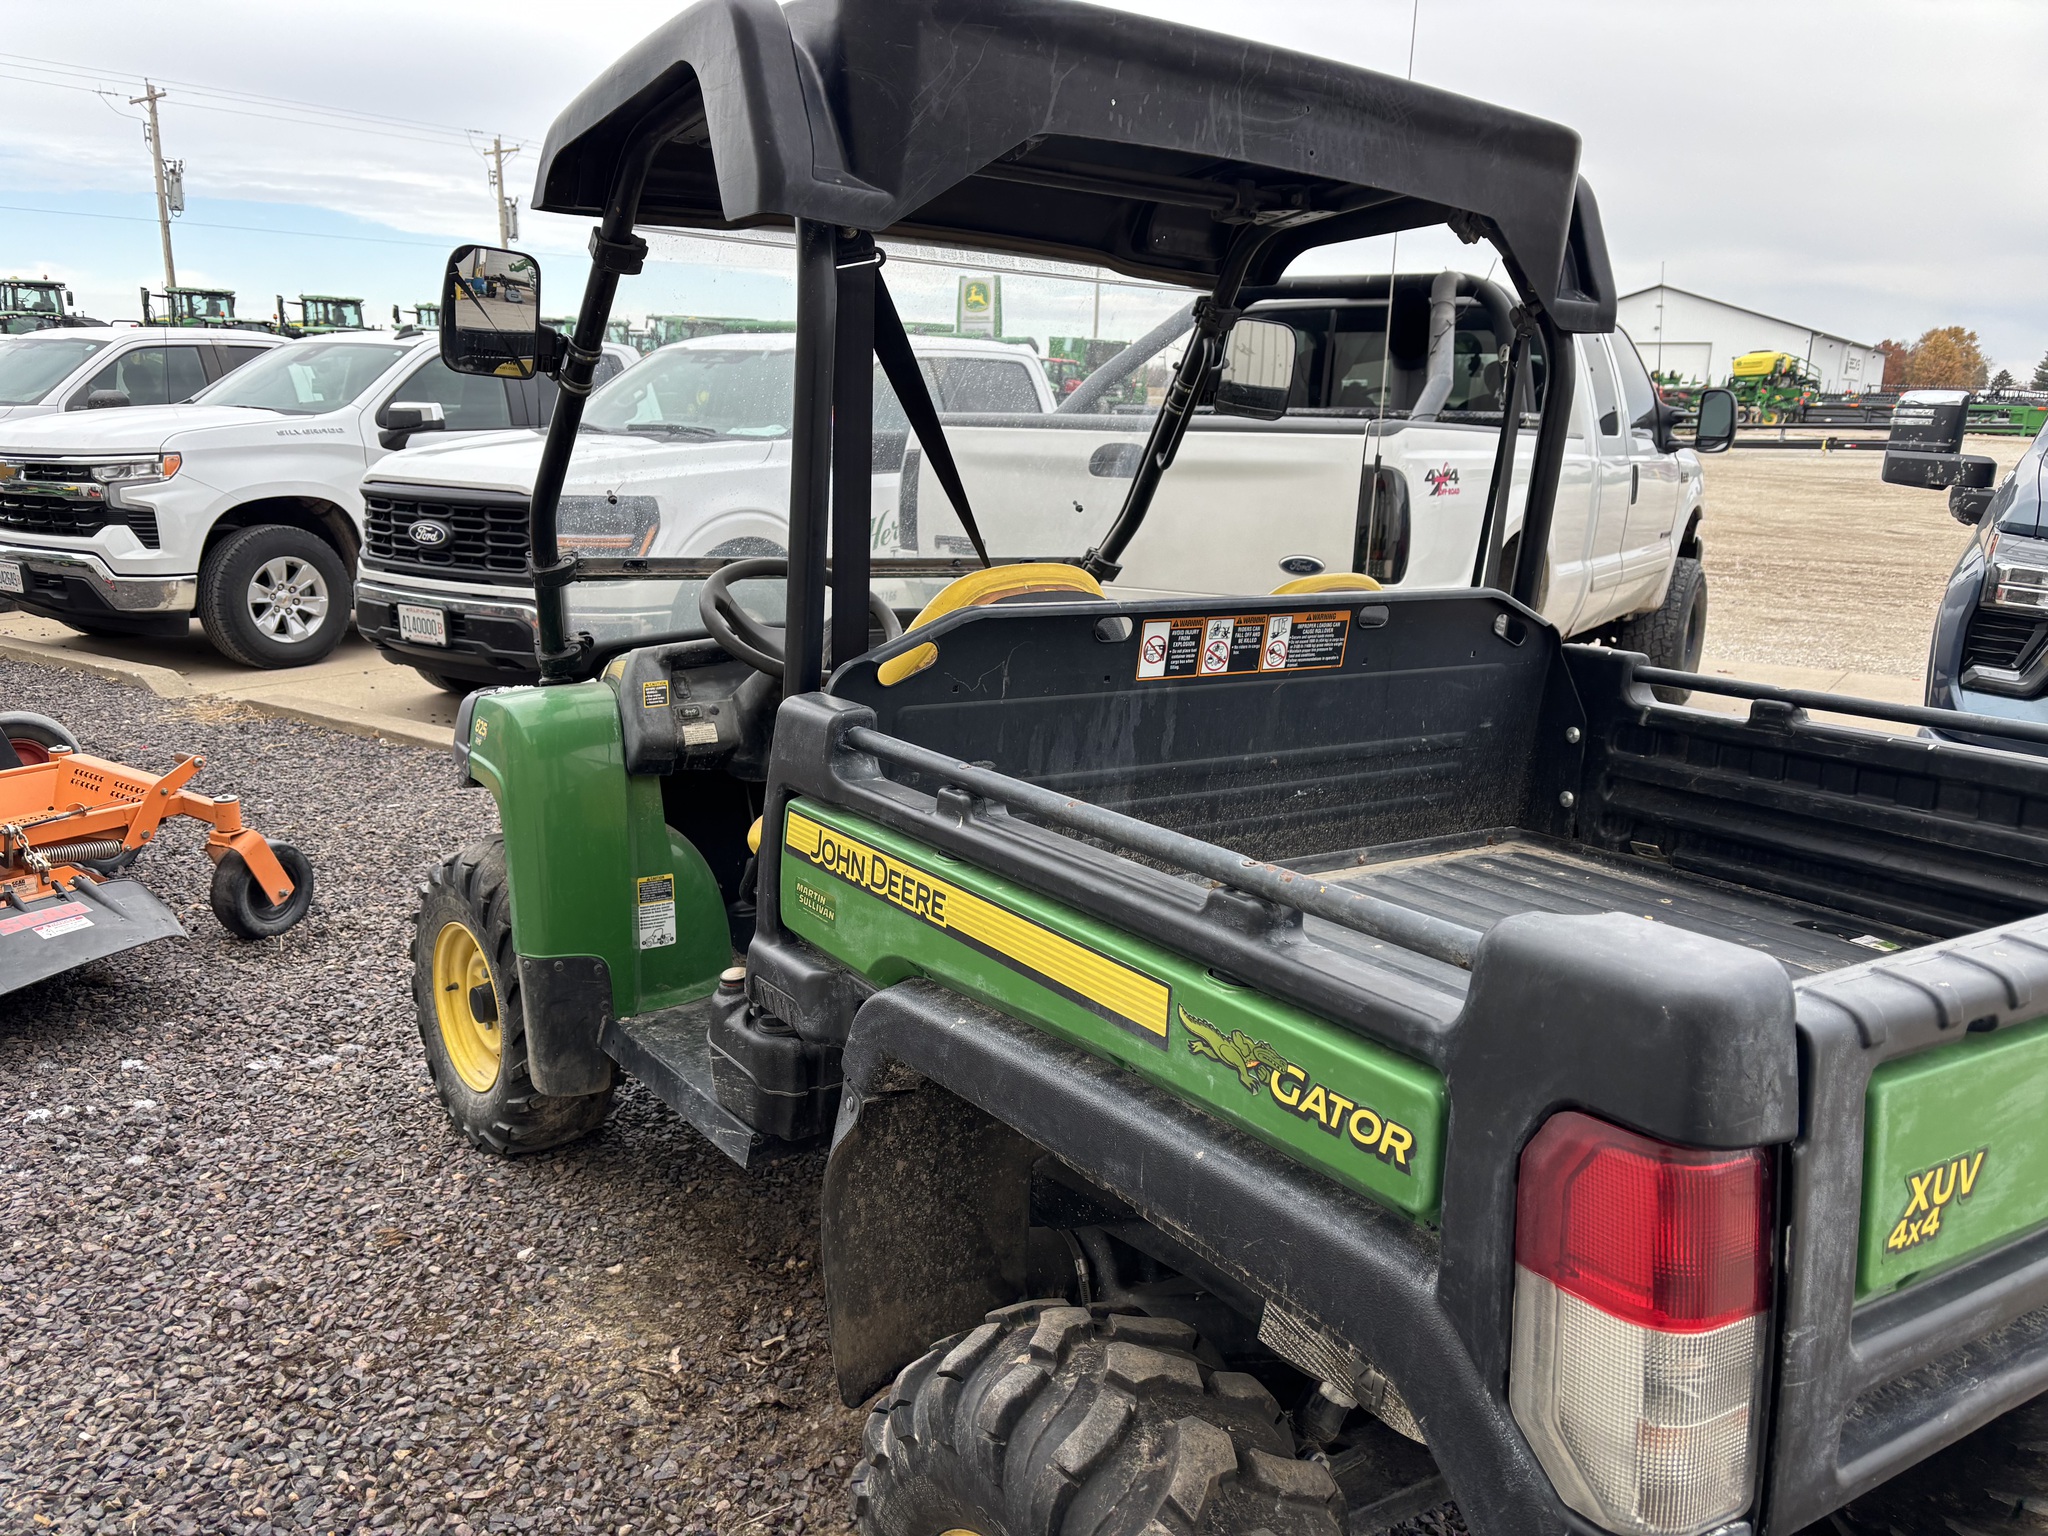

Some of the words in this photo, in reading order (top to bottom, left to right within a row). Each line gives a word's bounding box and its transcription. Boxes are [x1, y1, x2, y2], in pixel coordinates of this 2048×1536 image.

[415, 525, 438, 541] Ford
[1289, 560, 1314, 572] Ford
[402, 614, 437, 636] 4140000
[437, 622, 444, 635] B
[1179, 619, 1204, 627] WARNING
[1243, 616, 1266, 624] WARNING
[810, 829, 866, 882] JOHN
[871, 854, 947, 923] DEERE
[796, 883, 826, 905] MARTIN
[799, 894, 835, 921] SULLIVAN
[1270, 1063, 1414, 1168] GATOR
[1904, 1151, 1984, 1217] XUV
[1887, 1206, 1940, 1249] 4x4
